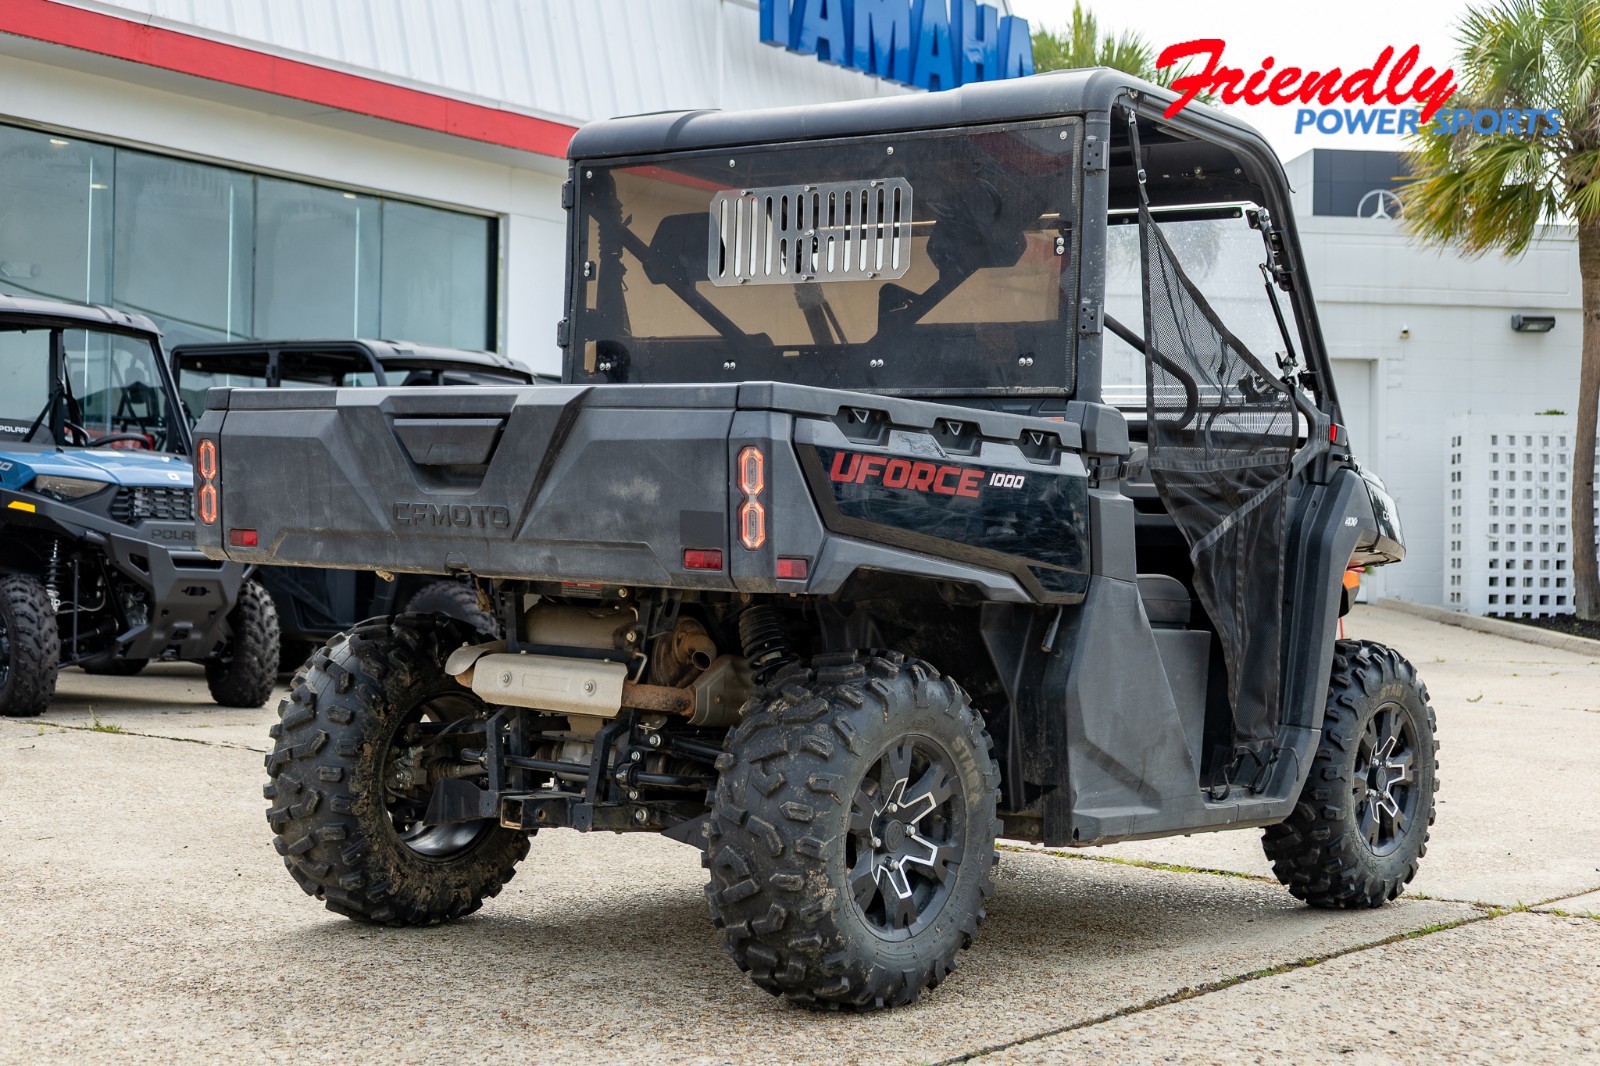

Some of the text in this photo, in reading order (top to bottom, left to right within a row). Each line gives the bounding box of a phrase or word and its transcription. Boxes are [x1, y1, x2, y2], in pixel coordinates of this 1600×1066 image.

[0, 425, 31, 434] POLARI
[830, 451, 1025, 498] UFORCE 1000
[393, 502, 509, 528] CFMOTO
